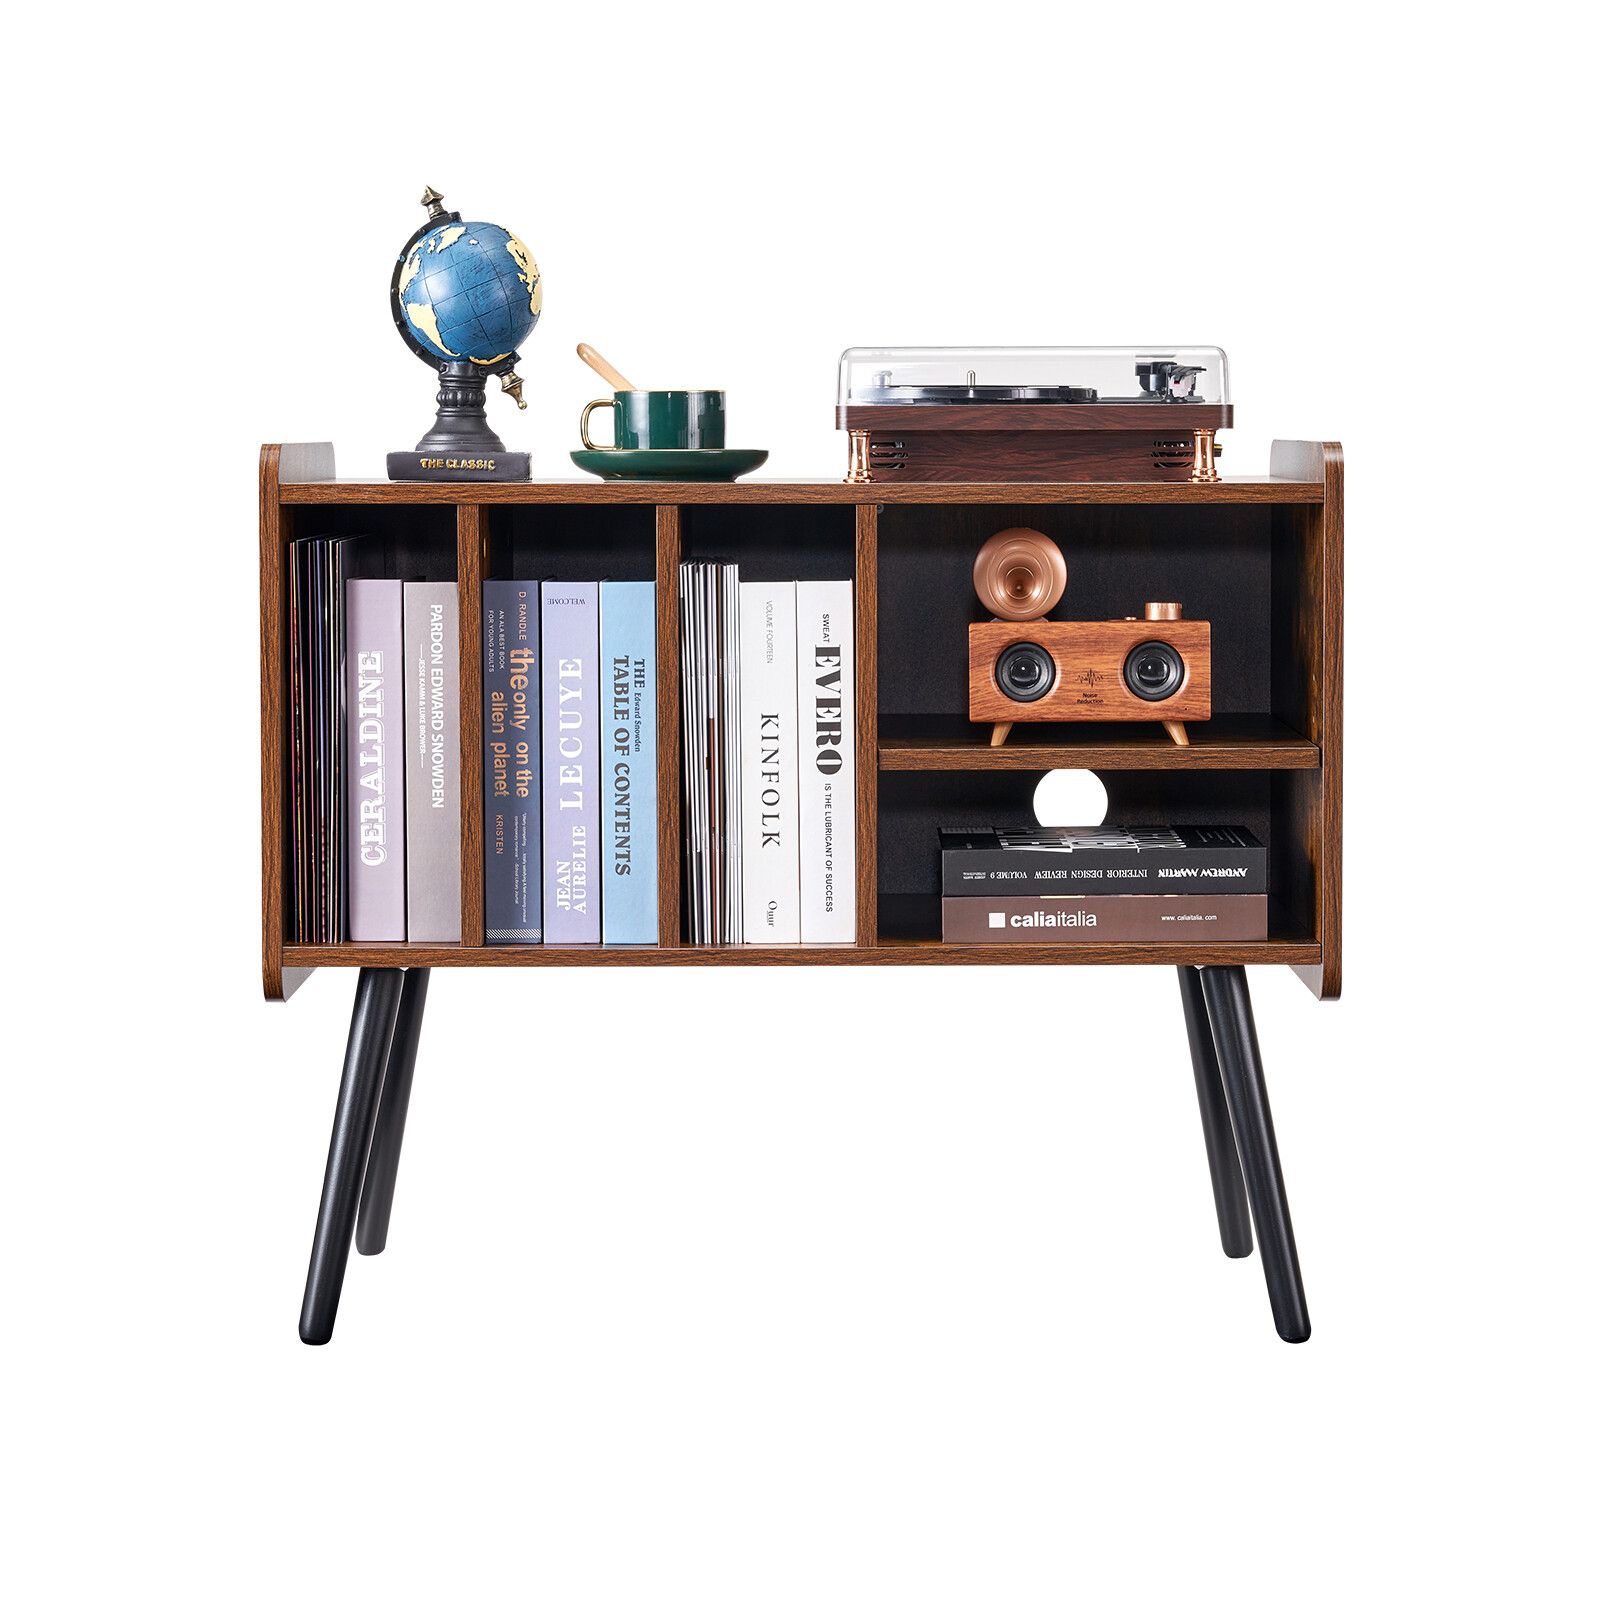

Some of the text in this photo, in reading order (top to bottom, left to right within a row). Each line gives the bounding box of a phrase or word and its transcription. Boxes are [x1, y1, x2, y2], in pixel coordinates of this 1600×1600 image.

[419, 458, 496, 471] THE CLASSIC
[519, 591, 526, 600] D.
[499, 610, 504, 619] AN
[418, 678, 426, 700] KAMM
[430, 604, 445, 808] PARDON EDWARD SNOWDEN
[634, 659, 645, 752] THE Edward Snowden
[815, 644, 843, 775] EVERO
[510, 648, 534, 798] the only on the
[559, 658, 583, 810] LECUYE
[490, 692, 510, 797] alien planet
[358, 651, 387, 866] CERALDINE
[613, 655, 631, 876] TABLE OF CONTENTS
[760, 713, 780, 848] KINFOLK
[825, 783, 831, 791] IS
[572, 825, 587, 914] AURELIE
[825, 860, 832, 870] OF
[996, 871, 1027, 879] VOLUME
[1034, 870, 1067, 879] REVIEW
[1071, 870, 1103, 878] DESIGN
[1107, 869, 1148, 878] INTERIOR
[1158, 868, 1197, 878] MARTIN
[1200, 868, 1247, 878] ANDREW
[556, 861, 571, 911] JEAN
[826, 873, 834, 912] SUCCESS
[1010, 911, 1096, 927] caliaitalia
